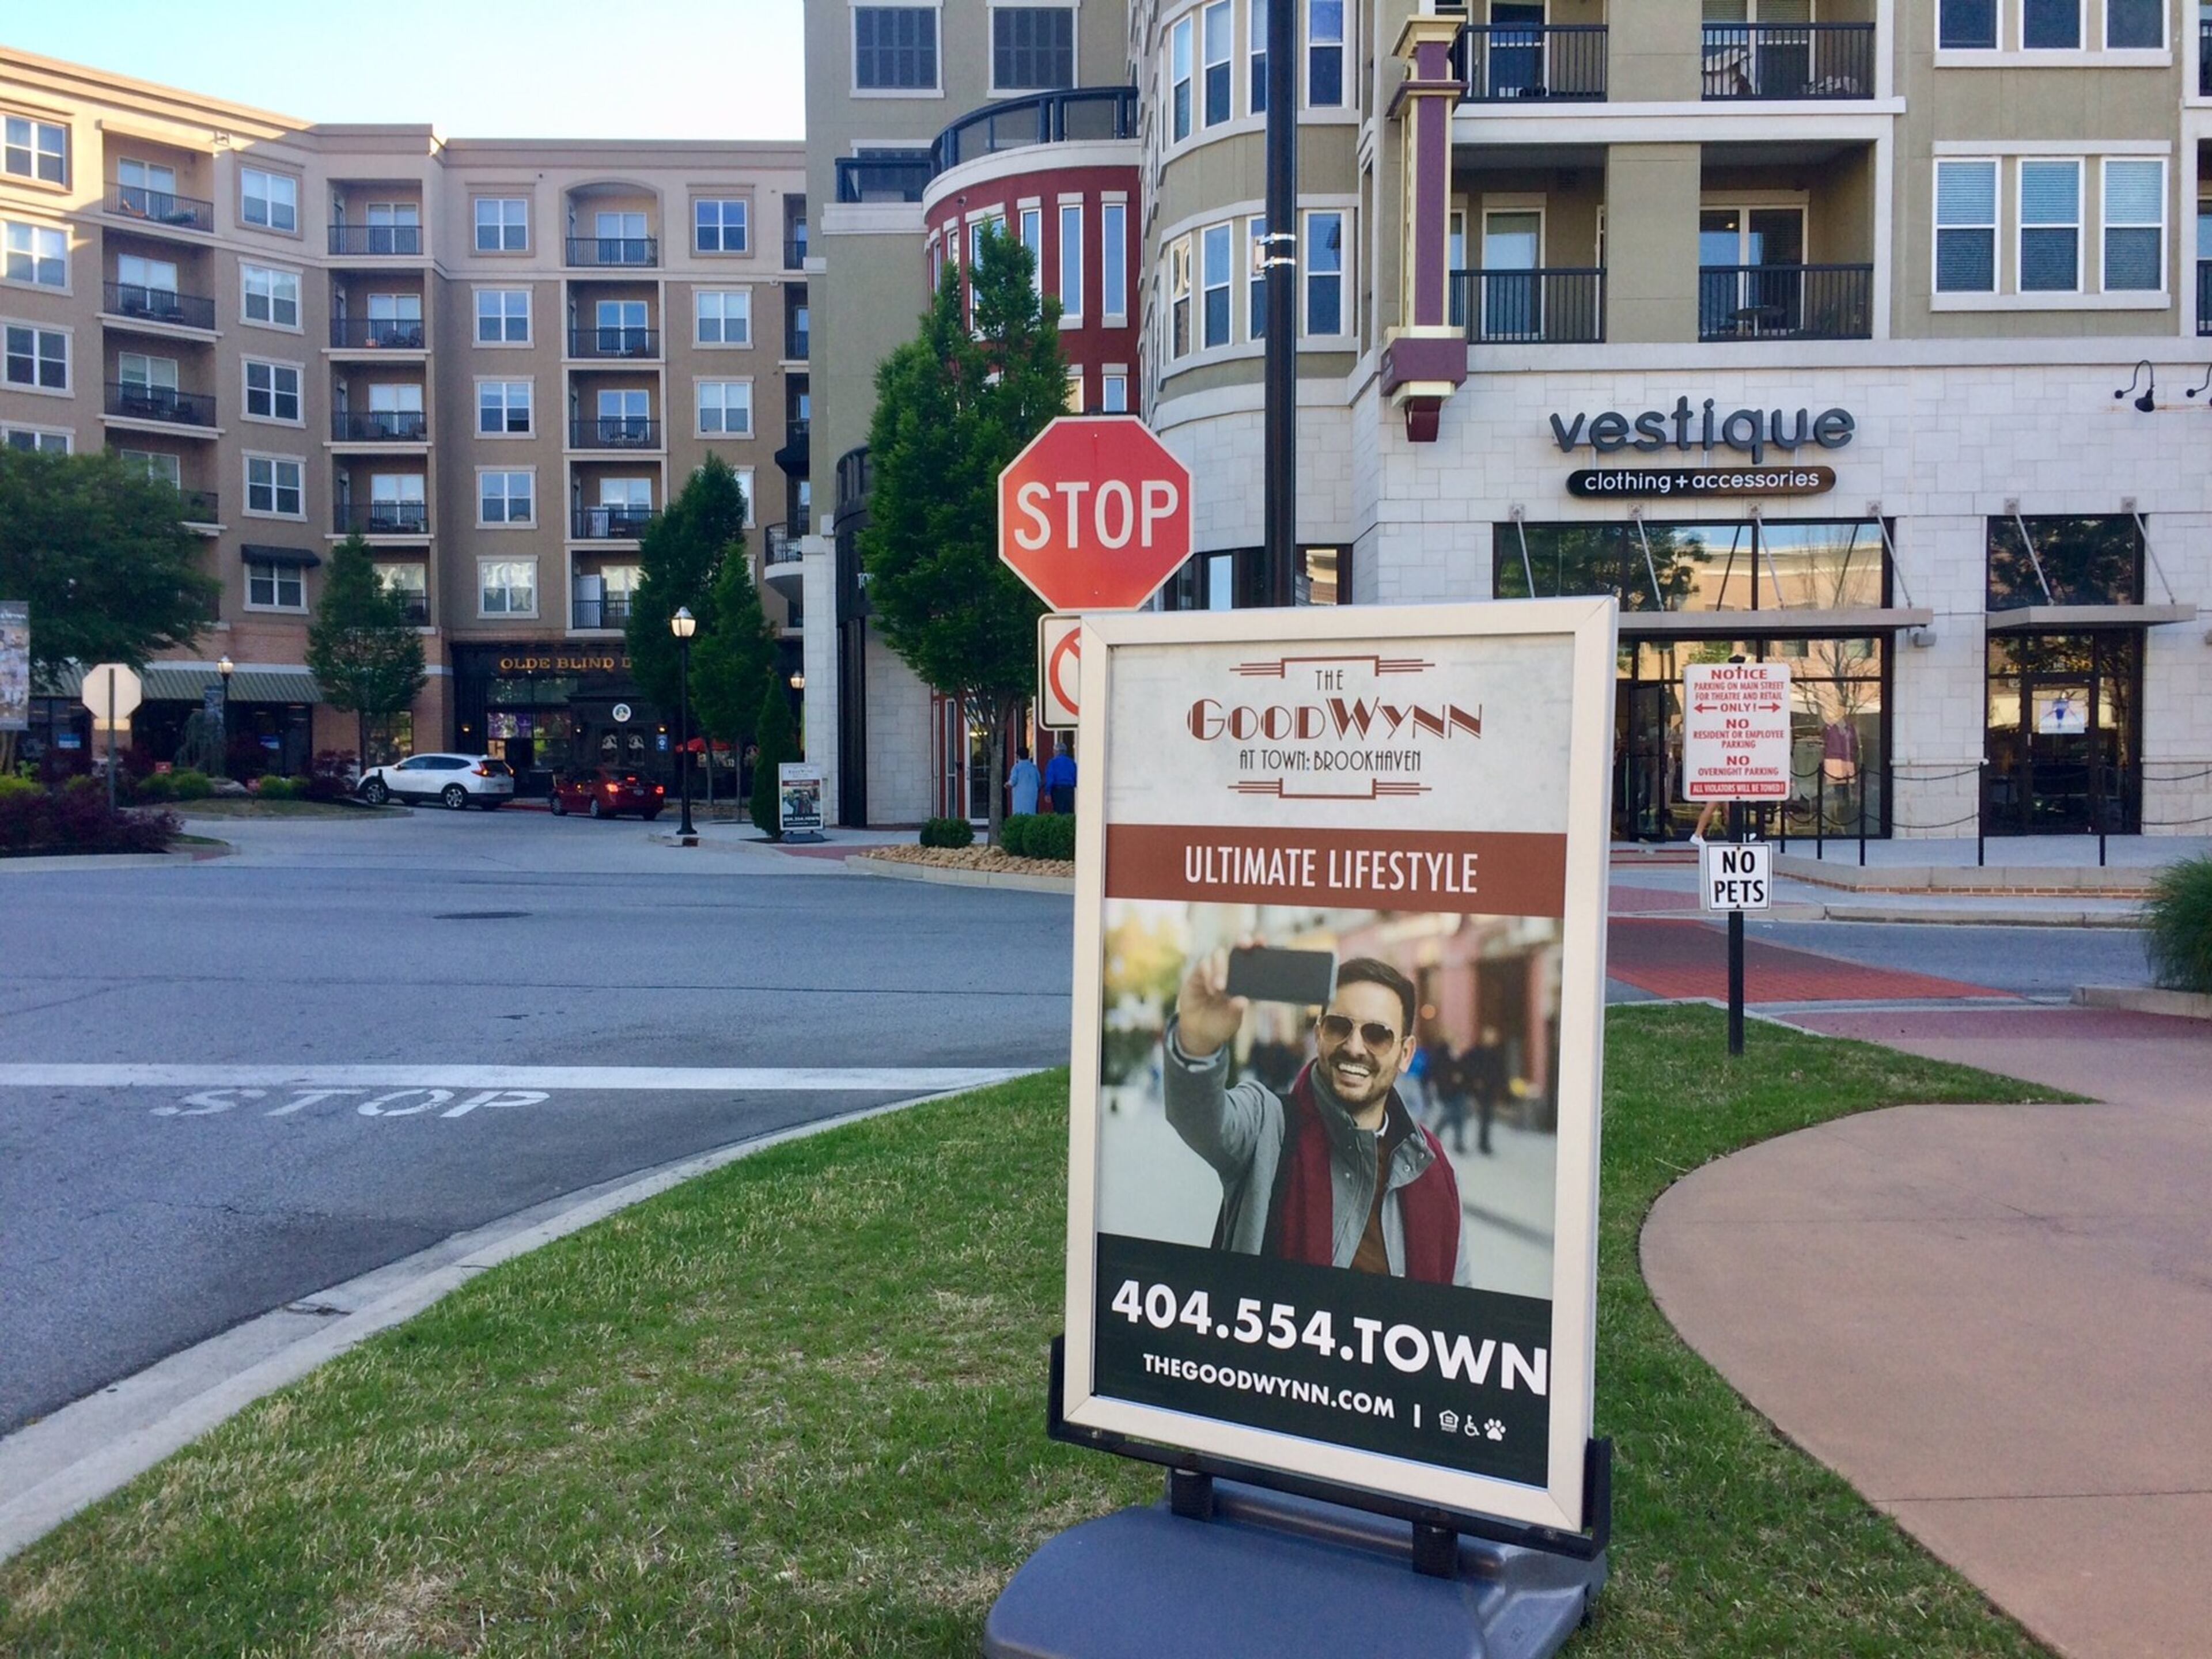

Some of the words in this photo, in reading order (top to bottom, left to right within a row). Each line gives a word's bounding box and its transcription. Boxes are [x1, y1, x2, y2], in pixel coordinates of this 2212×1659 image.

[1550, 396, 1855, 464] vestique
[1585, 472, 1671, 493] clothing
[1692, 470, 1819, 488] accessories
[1014, 480, 1179, 551] STOP
[501, 658, 550, 669] OLDE
[556, 657, 615, 669] BLIND
[1315, 669, 1344, 691] THE
[1711, 669, 1767, 680] NOTICE
[1694, 683, 1725, 691] PARKING
[1740, 682, 1758, 690] MAIN
[1760, 681, 1784, 690] STREET
[1695, 692, 1709, 700] FOR
[1711, 692, 1740, 700] THEATRE
[1760, 692, 1783, 700] RETAIL
[1694, 731, 1729, 739] RESIDENT
[1745, 730, 1784, 738] EMPLOYEE
[1726, 719, 1749, 729] NO
[1721, 740, 1756, 748] PARKING
[1240, 749, 1256, 770] AT
[1314, 750, 1421, 771] BROOKHAVEN
[1726, 756, 1750, 766] NO
[1698, 768, 1742, 776] OVERNIGHT
[1744, 768, 1779, 776] PARKING
[1692, 784, 1703, 793] ALL
[1736, 784, 1750, 793] WILL
[1751, 784, 1759, 793] BE
[1185, 846, 1316, 887] ULTIMATE
[1328, 850, 1478, 893] LIFESTYLE
[1722, 851, 1755, 873] NO
[1714, 880, 1764, 903] PETS
[148, 1089, 551, 1118] STOP
[1112, 1279, 1547, 1396] 404.554.TOWN
[1143, 1353, 1395, 1419] THEGOODWYNN.COM
